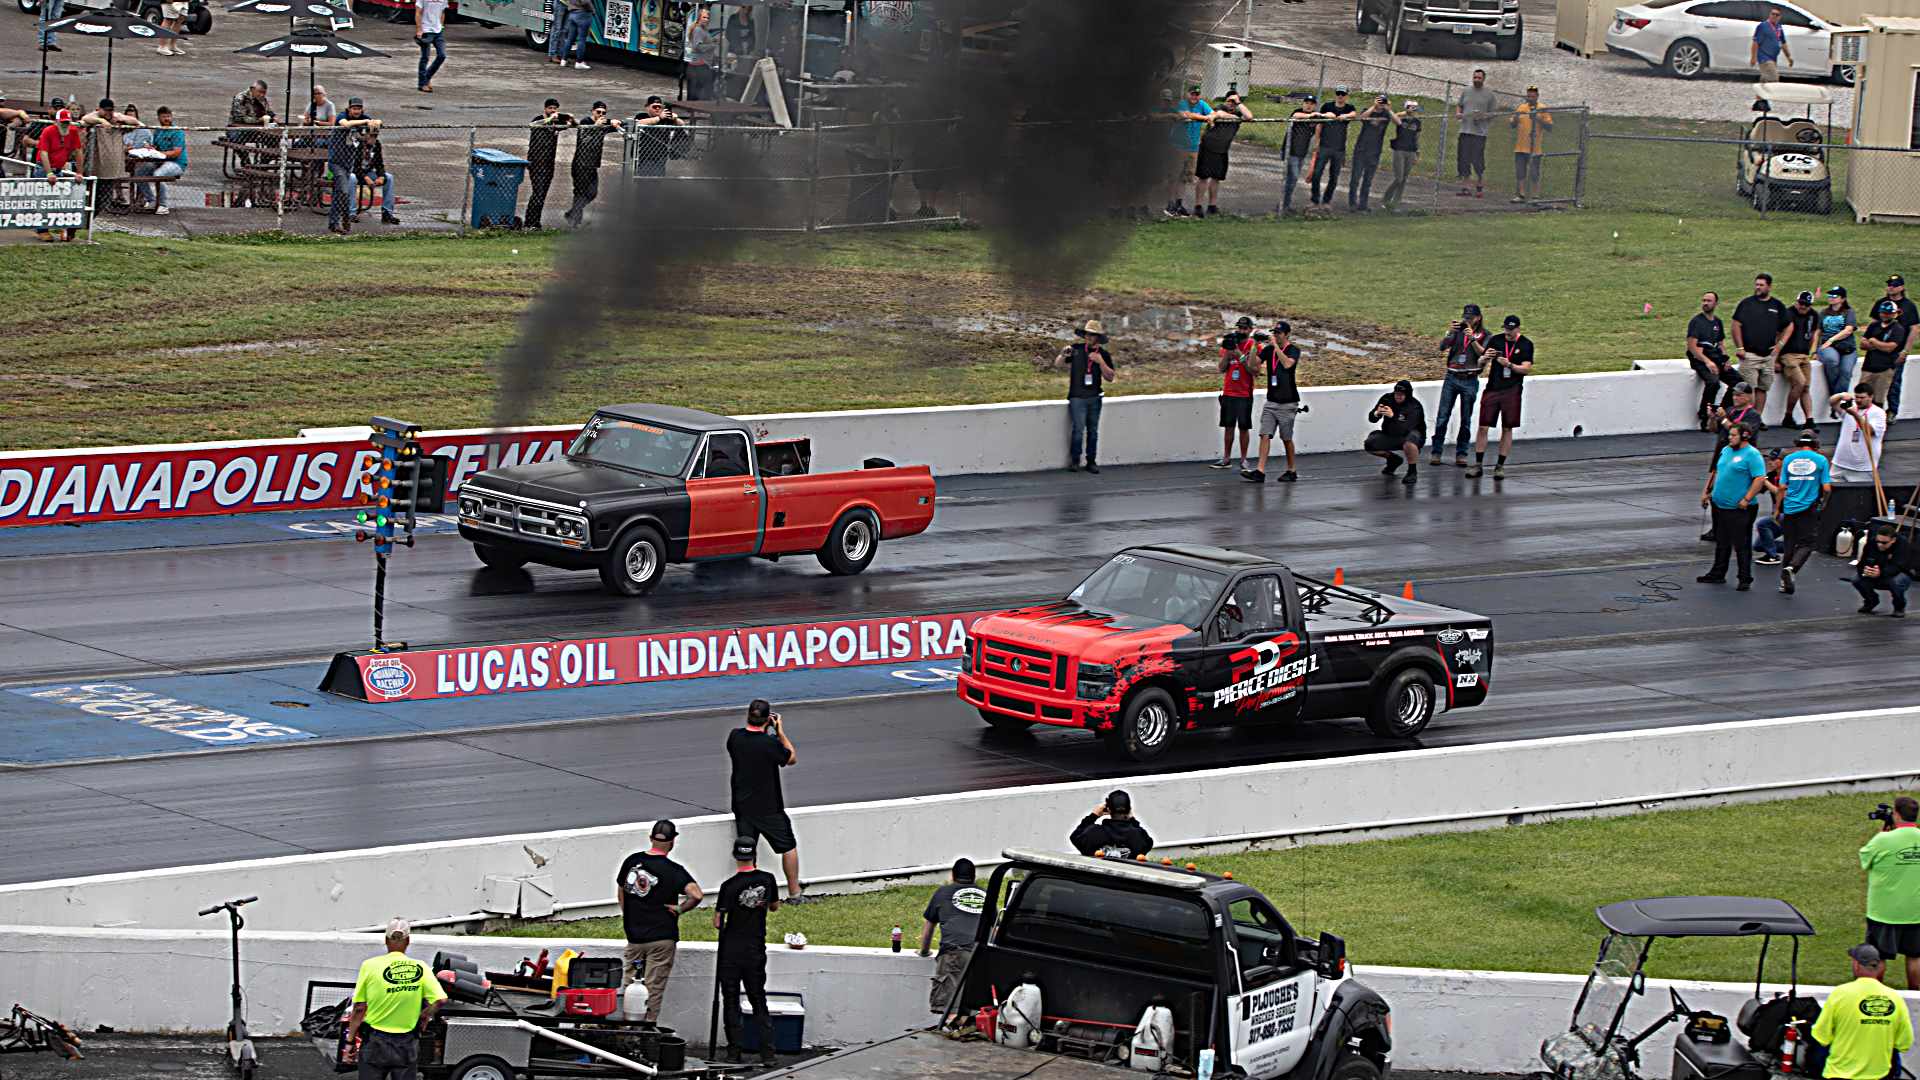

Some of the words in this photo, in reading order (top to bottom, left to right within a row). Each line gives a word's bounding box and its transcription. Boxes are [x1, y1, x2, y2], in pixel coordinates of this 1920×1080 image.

[40, 199, 84, 209] SERVICE
[437, 646, 550, 694] LUCAS
[559, 642, 616, 685] OIL
[638, 621, 911, 679] INDIANAPOLIS
[1213, 672, 1266, 709] PIERCE
[1460, 674, 1477, 684] NX
[1252, 981, 1299, 1013] PLOUGHE'S
[1275, 1002, 1297, 1019] SERVICE
